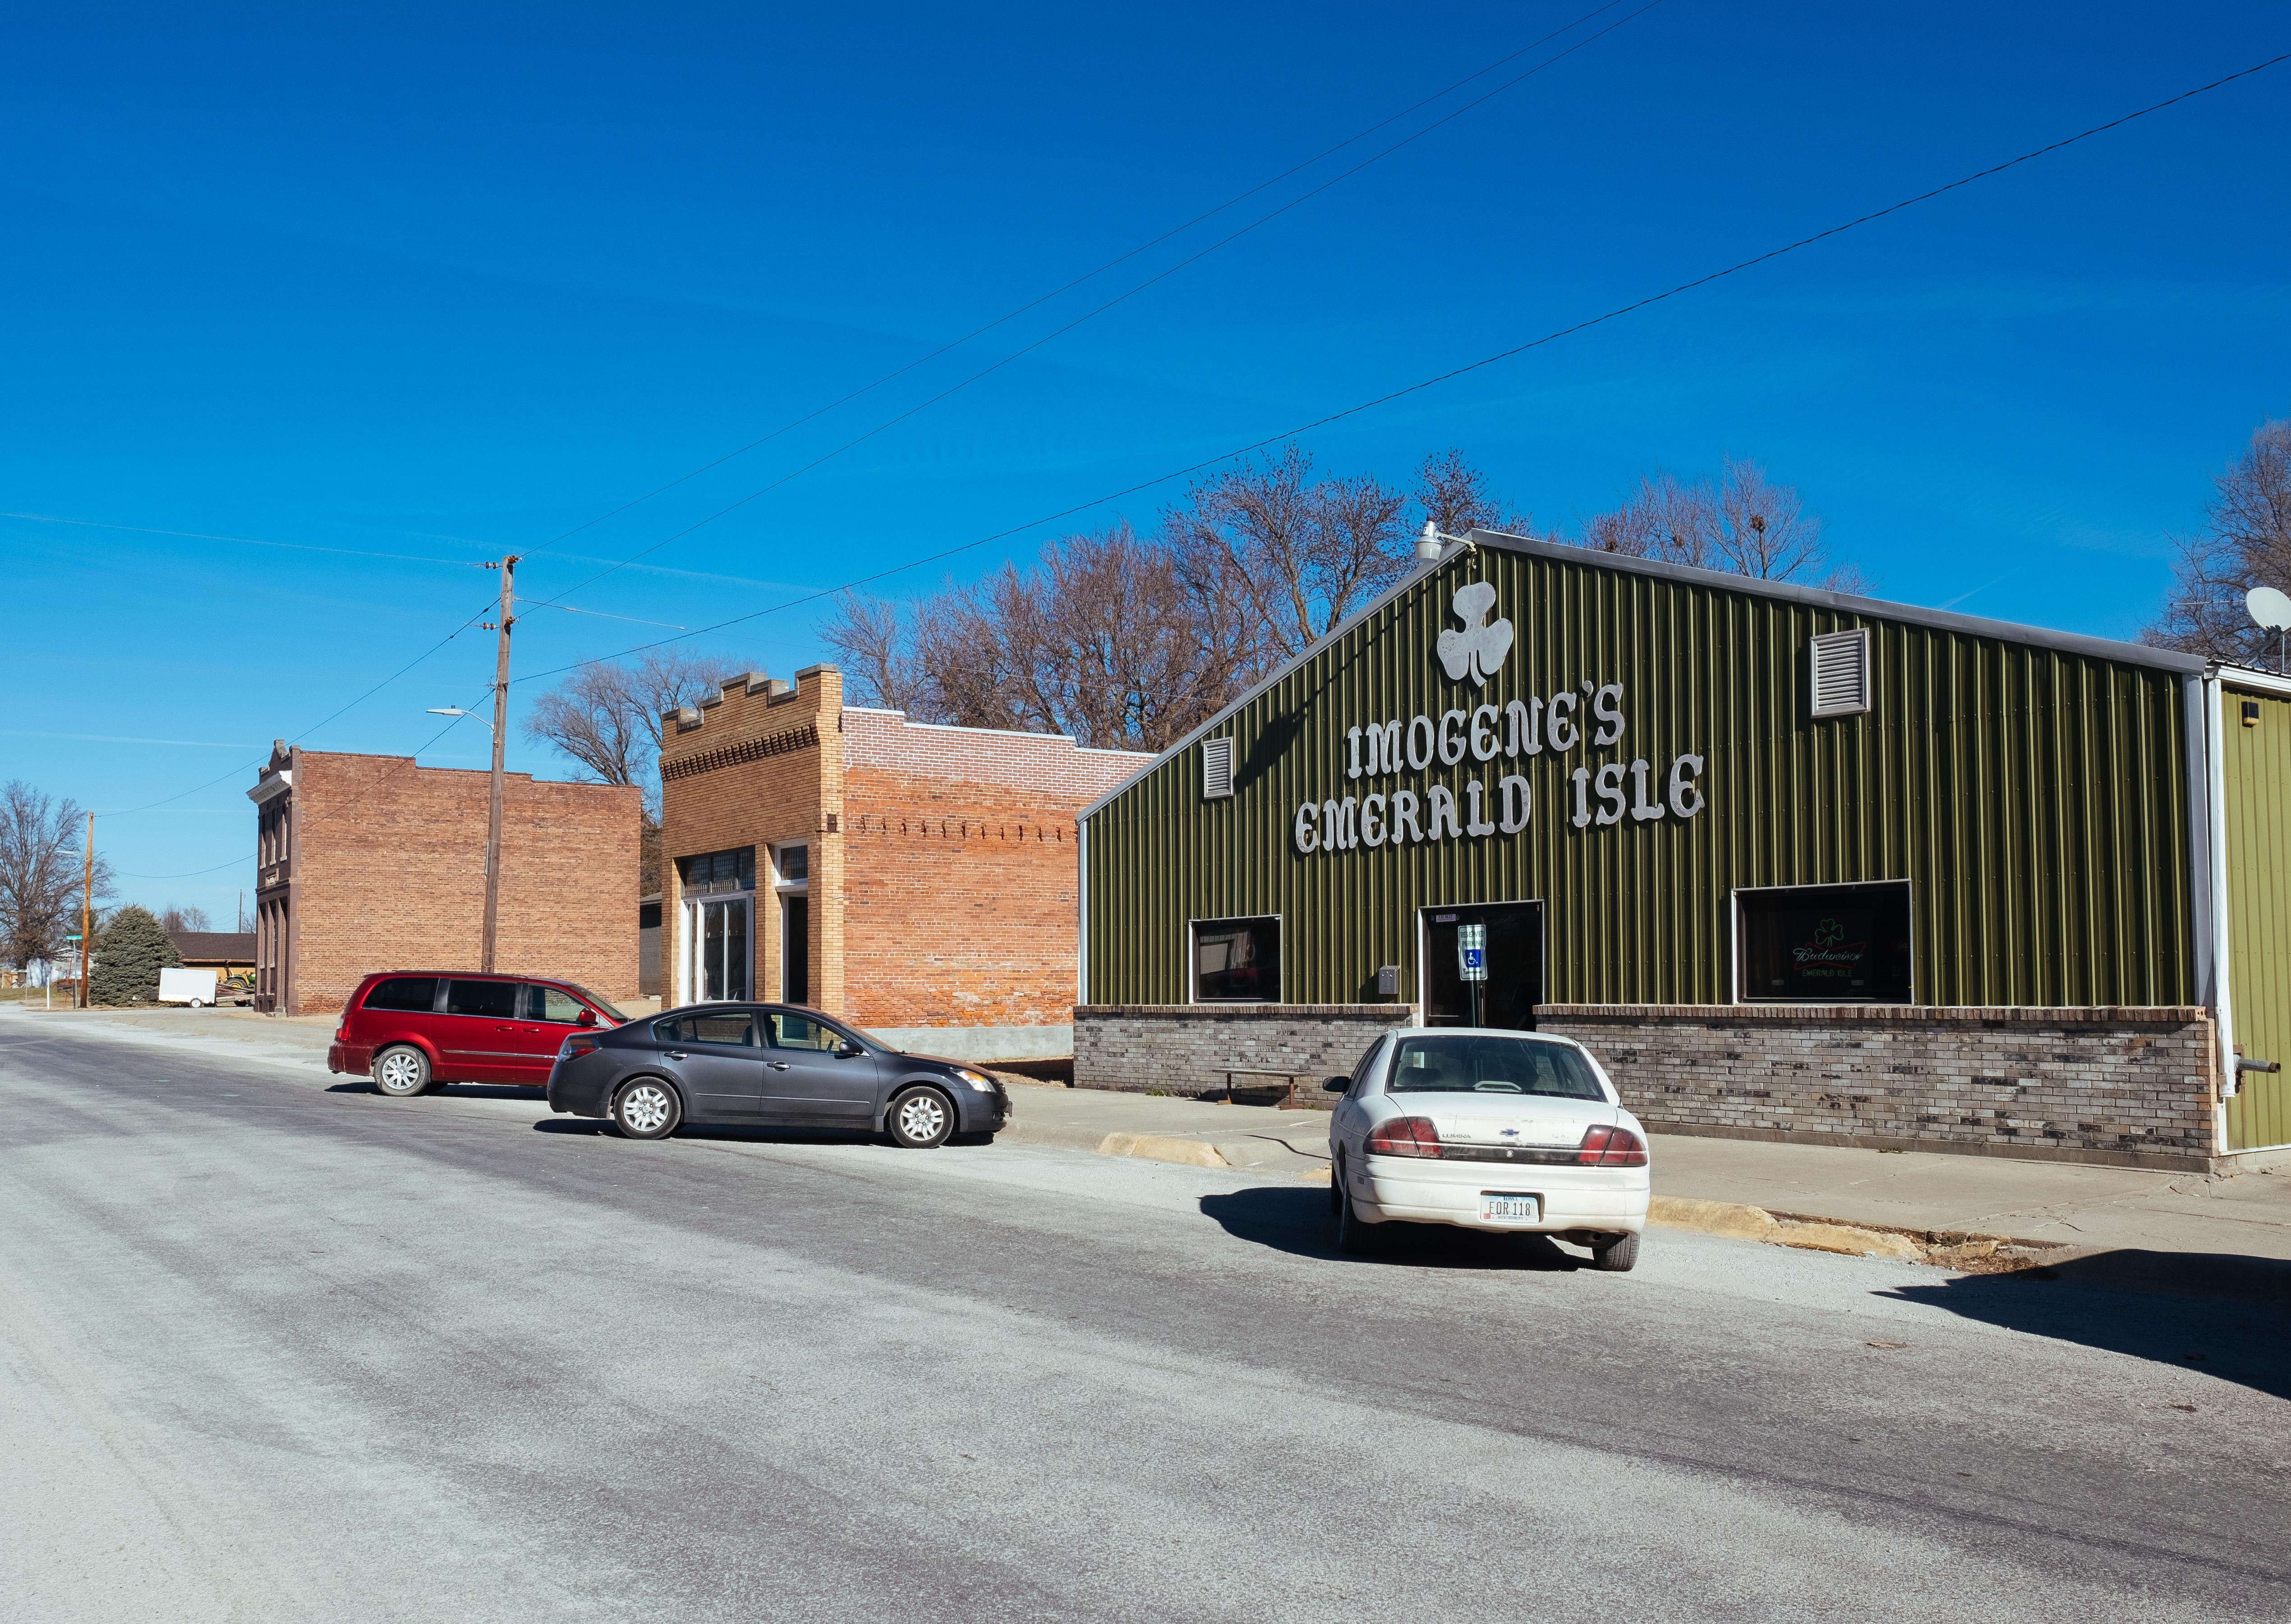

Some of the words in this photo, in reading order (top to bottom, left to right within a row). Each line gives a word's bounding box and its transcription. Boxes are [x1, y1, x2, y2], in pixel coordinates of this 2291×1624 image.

[1347, 680, 1625, 779] IMOGENE'S
[1295, 775, 1531, 853] EMERALD
[1572, 753, 1705, 828] ISLE
[1793, 948, 1863, 962] Budweiser
[1513, 1202, 1531, 1216] 118
